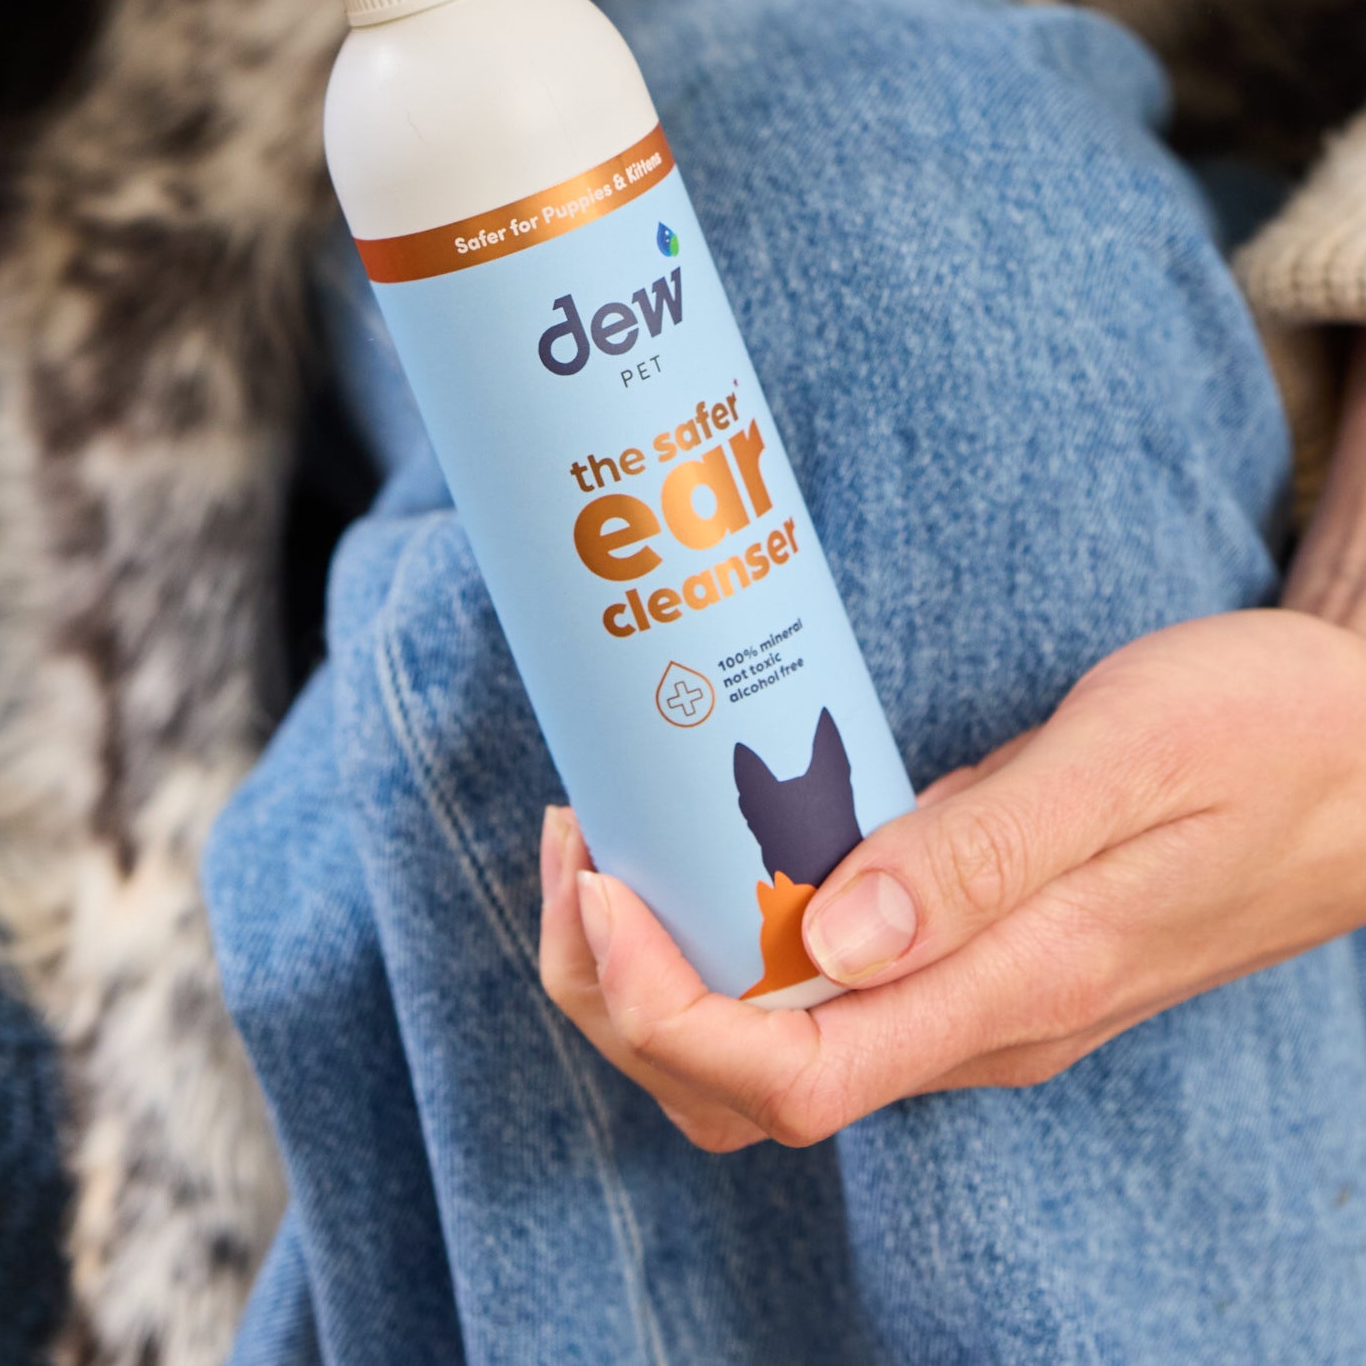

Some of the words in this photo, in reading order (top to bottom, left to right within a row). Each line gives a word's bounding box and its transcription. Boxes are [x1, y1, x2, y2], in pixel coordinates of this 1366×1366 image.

[454, 223, 507, 255] Safer
[508, 213, 539, 237] for
[541, 180, 613, 225] Puppies
[612, 173, 626, 191] &
[625, 152, 662, 183] Kittens
[538, 266, 683, 376] dew
[620, 354, 663, 388] PET
[569, 447, 646, 493] the
[651, 391, 740, 464] safer
[572, 417, 774, 583] ear
[601, 516, 800, 639] cleanser
[718, 646, 759, 672] 100%
[759, 618, 803, 652] mineral
[723, 669, 749, 688] not
[749, 652, 782, 676] toxic
[729, 670, 781, 703] alcohol
[780, 657, 804, 678] free
